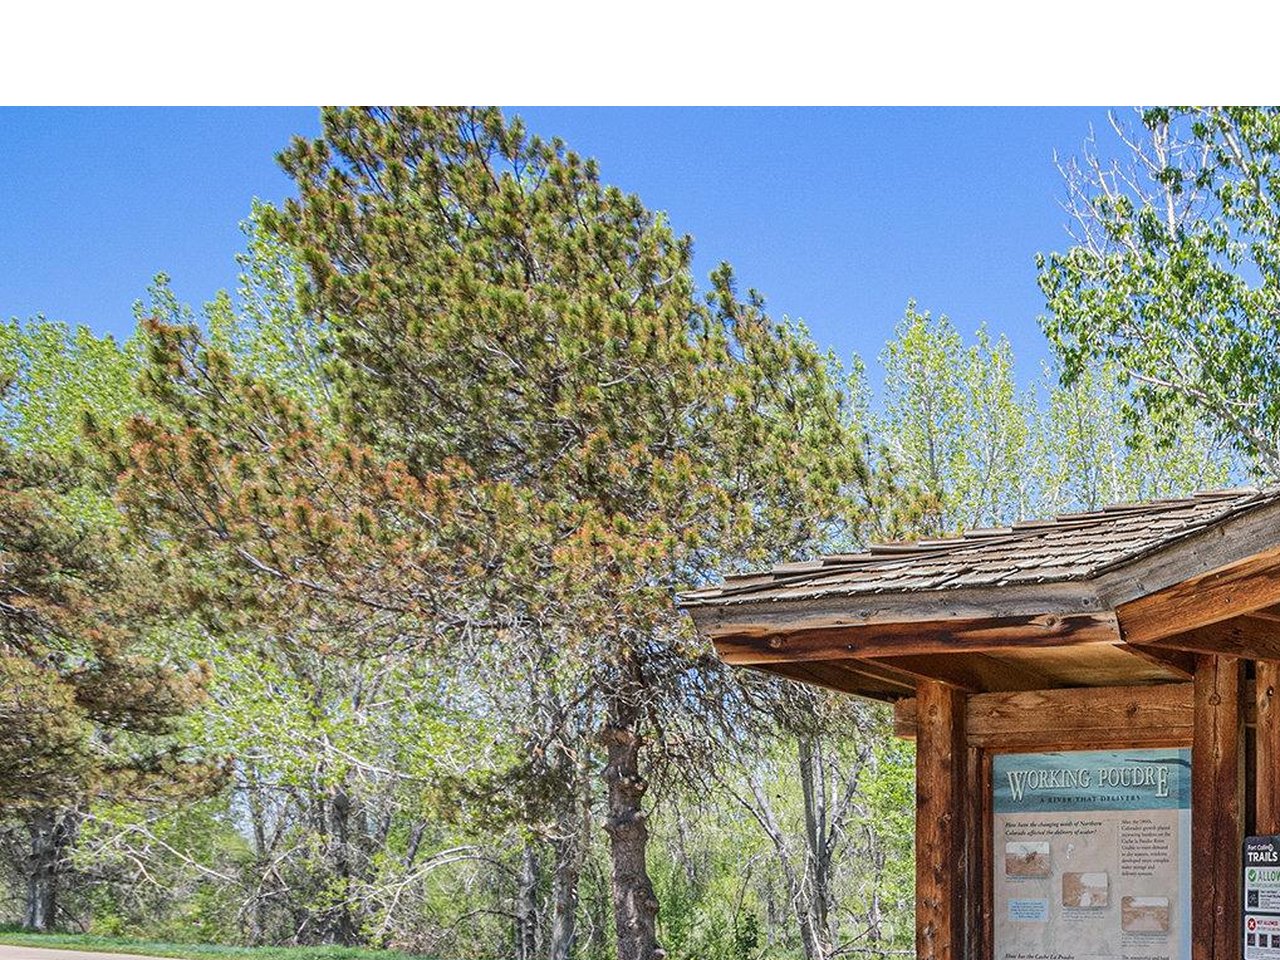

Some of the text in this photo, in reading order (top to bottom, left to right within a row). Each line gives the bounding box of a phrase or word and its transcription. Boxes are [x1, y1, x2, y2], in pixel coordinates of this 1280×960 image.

[1006, 766, 1169, 802] WORKING POUDRE
[1248, 851, 1278, 862] TRAILS
